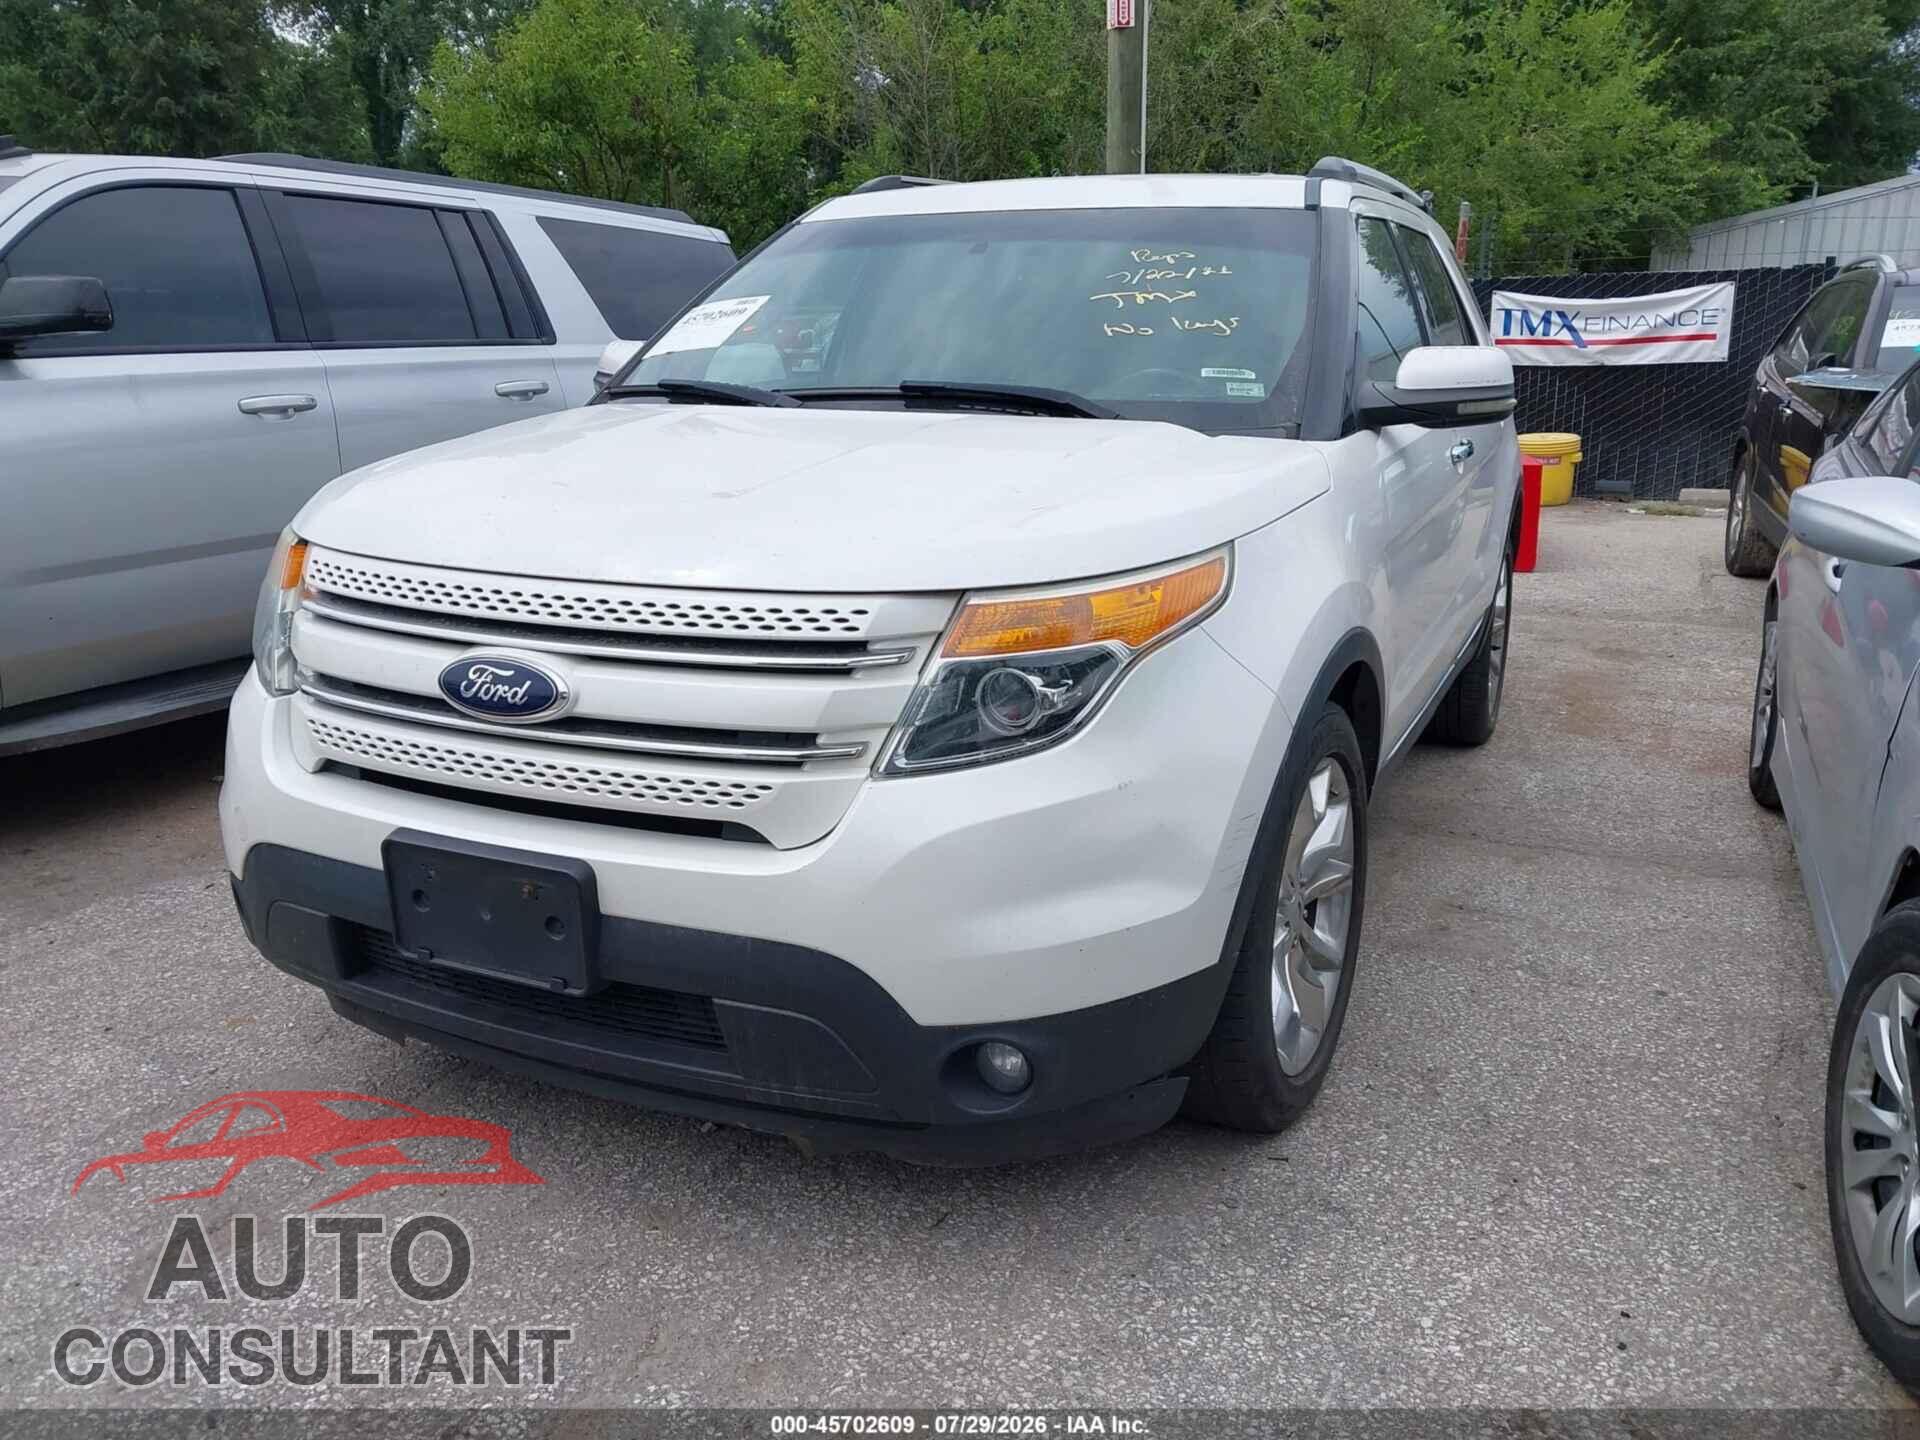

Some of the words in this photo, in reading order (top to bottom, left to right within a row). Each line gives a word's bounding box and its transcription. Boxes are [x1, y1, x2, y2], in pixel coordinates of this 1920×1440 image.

[1496, 308, 1588, 348] TMX
[1583, 308, 1720, 332] FINANCE
[460, 664, 532, 705] Ford
